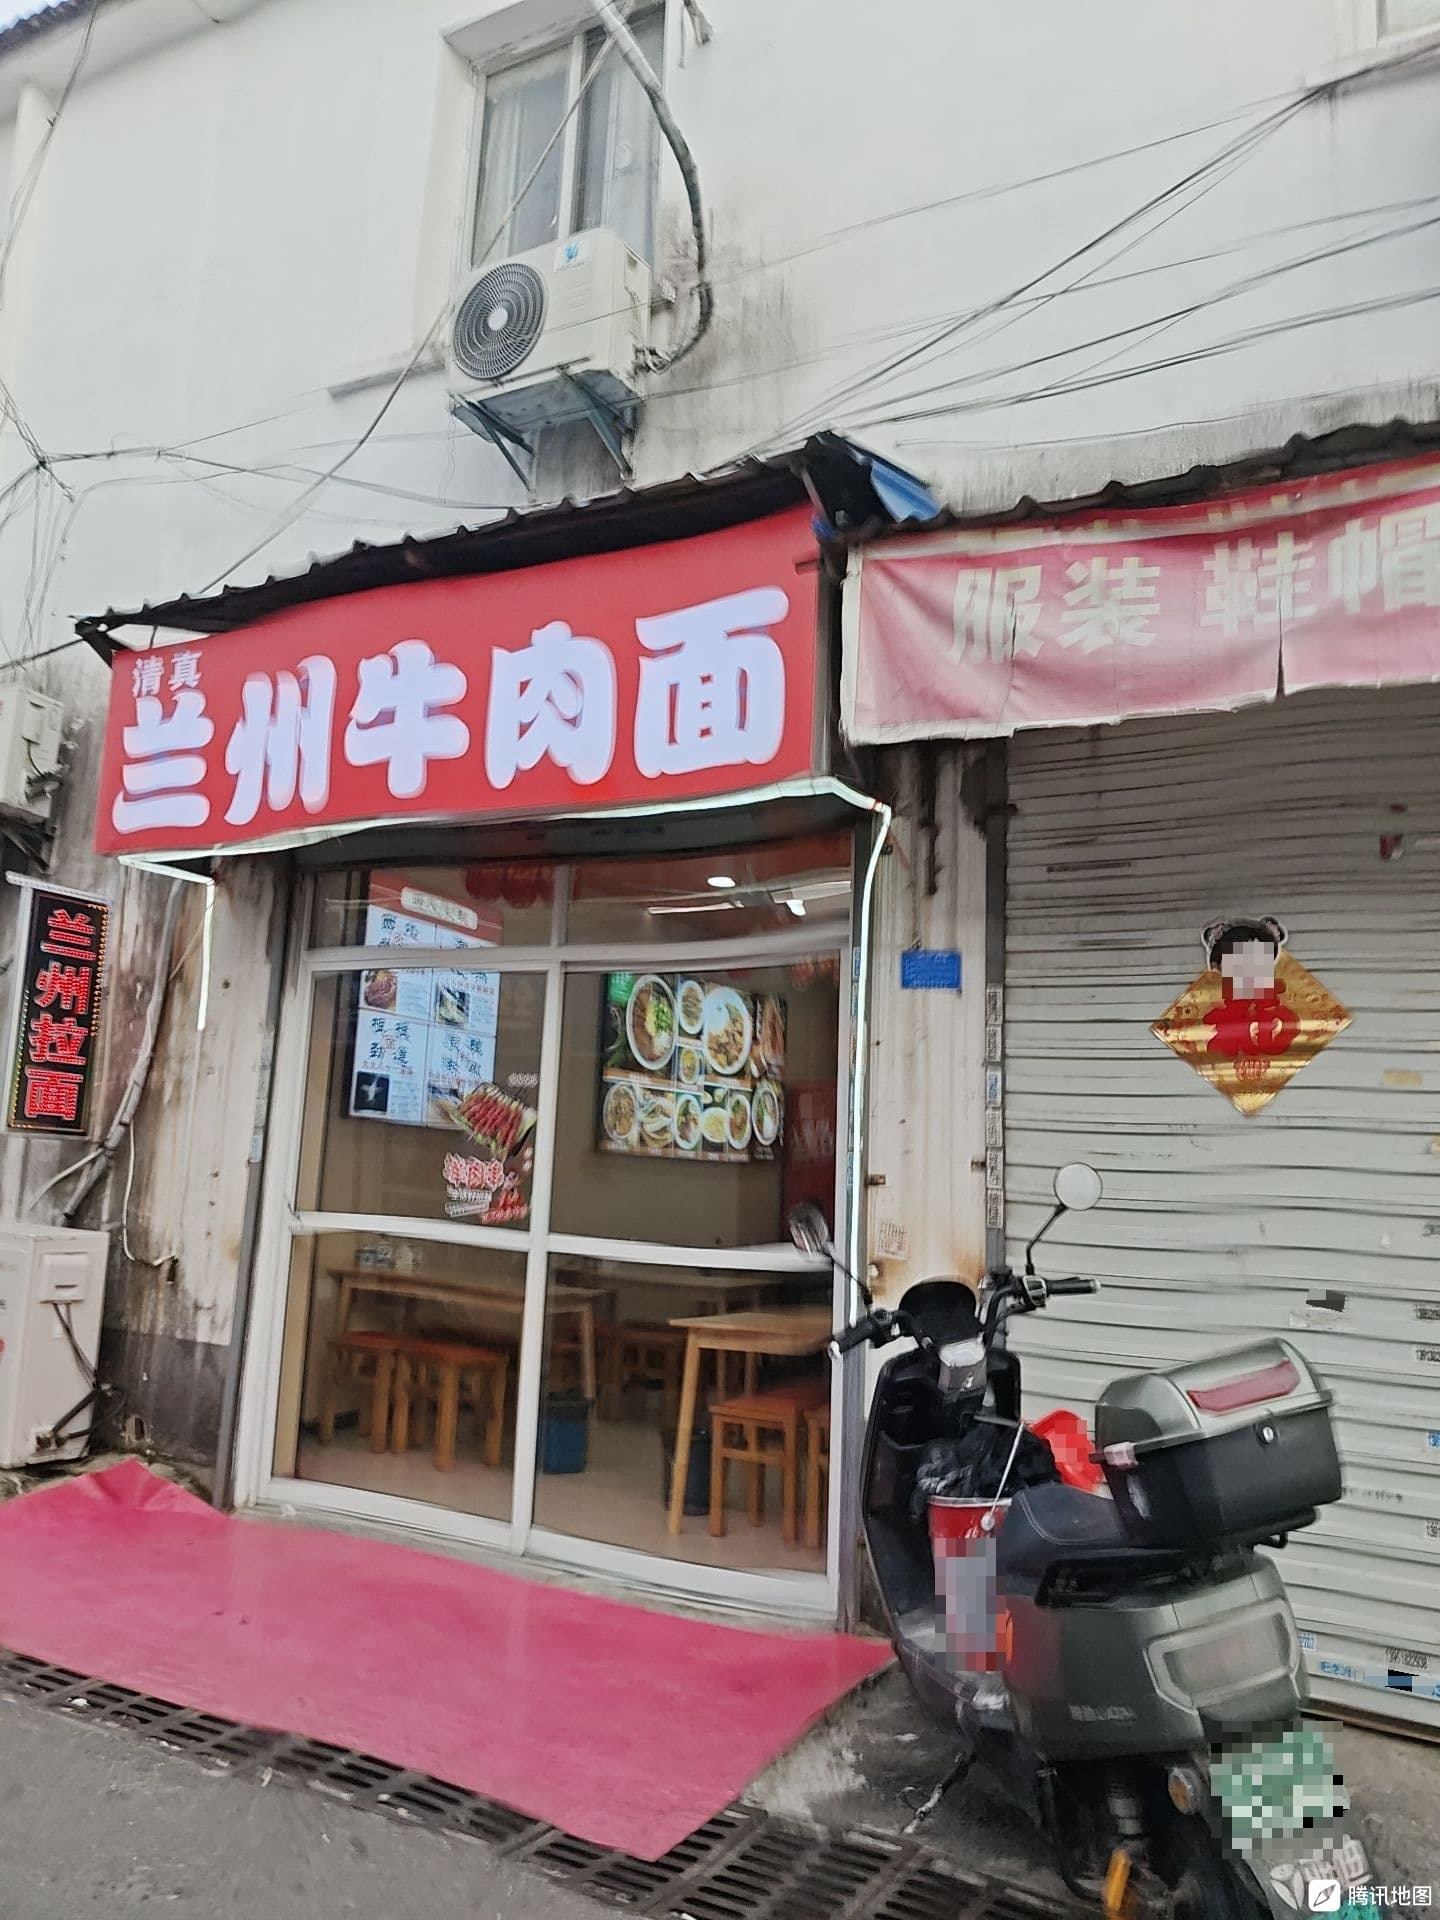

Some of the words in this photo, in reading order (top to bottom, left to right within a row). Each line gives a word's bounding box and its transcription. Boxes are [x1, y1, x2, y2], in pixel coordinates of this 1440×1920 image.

[111, 585, 790, 834] 兰州牛肉面
[131, 649, 203, 697] 清真
[24, 908, 97, 1121] 兰州拉面
